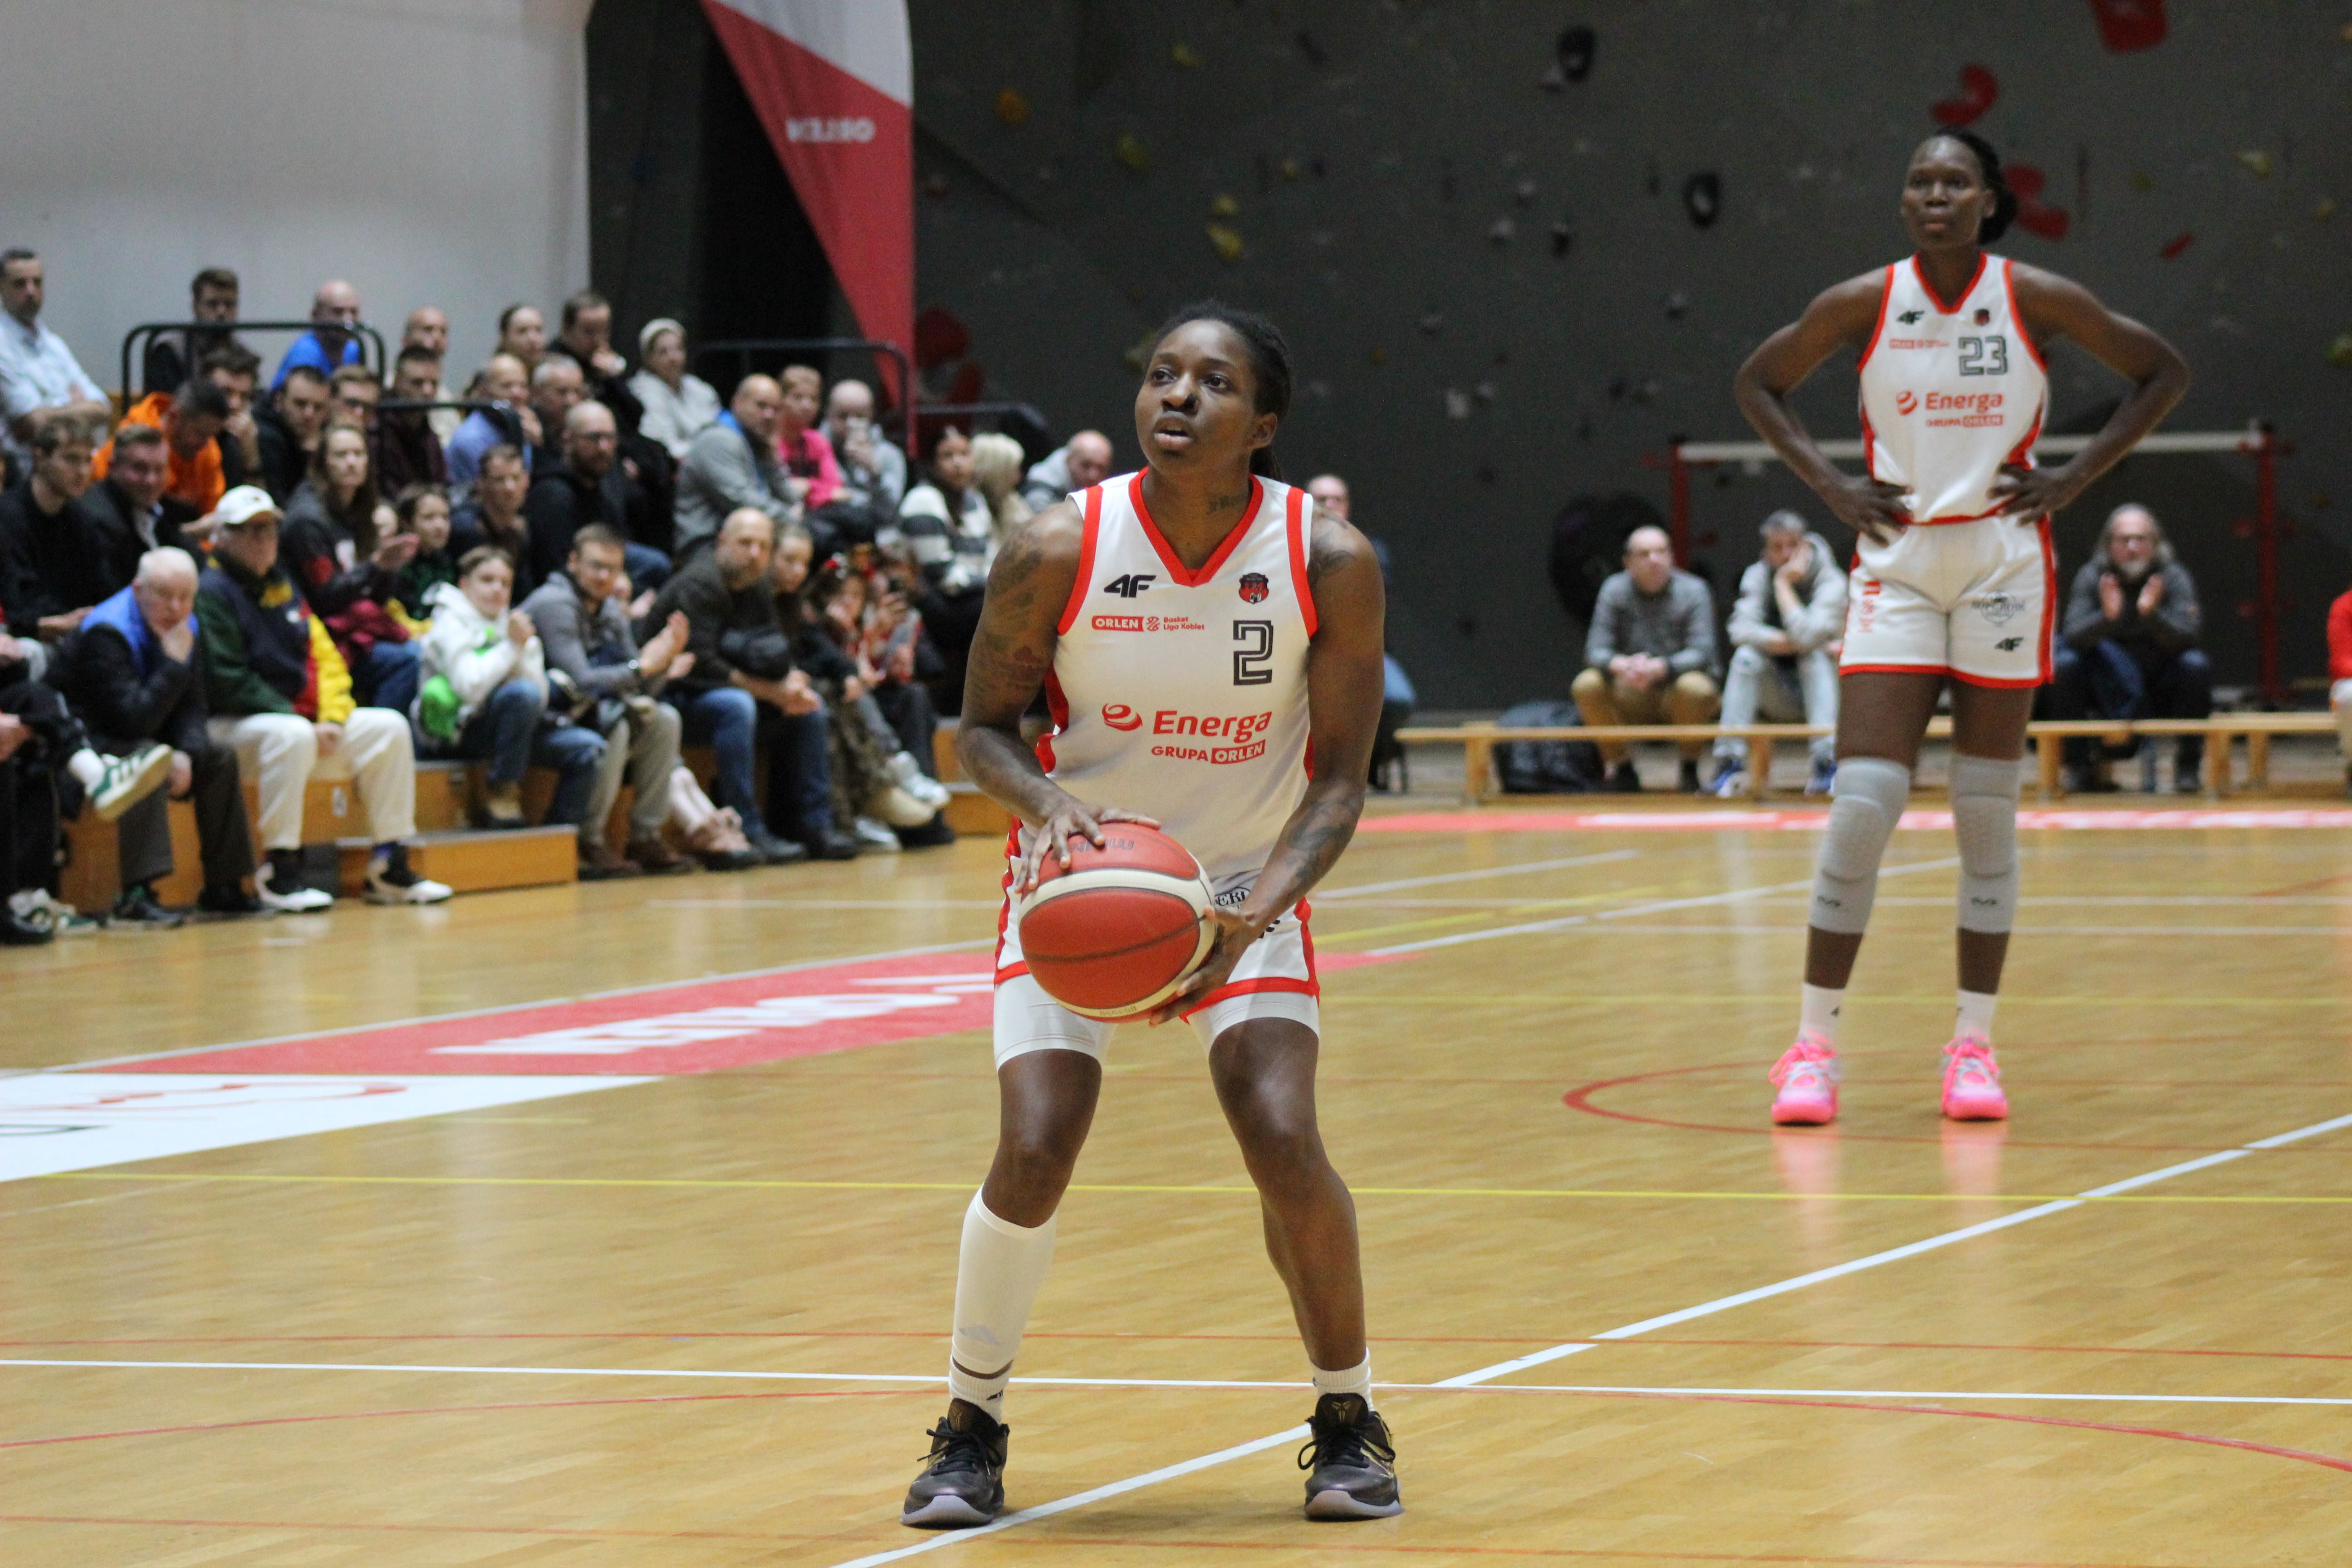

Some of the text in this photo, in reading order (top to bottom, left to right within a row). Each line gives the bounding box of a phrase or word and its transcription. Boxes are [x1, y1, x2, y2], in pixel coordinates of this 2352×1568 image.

[1958, 335, 2008, 376] 23
[1926, 392, 2003, 414] Energa
[1104, 574, 1156, 598] 4F
[1095, 618, 1139, 629] ORLEN
[1233, 620, 1274, 686] 2
[1153, 710, 1272, 743] Energa
[1151, 742, 1263, 762] GRUPA ORLEN
